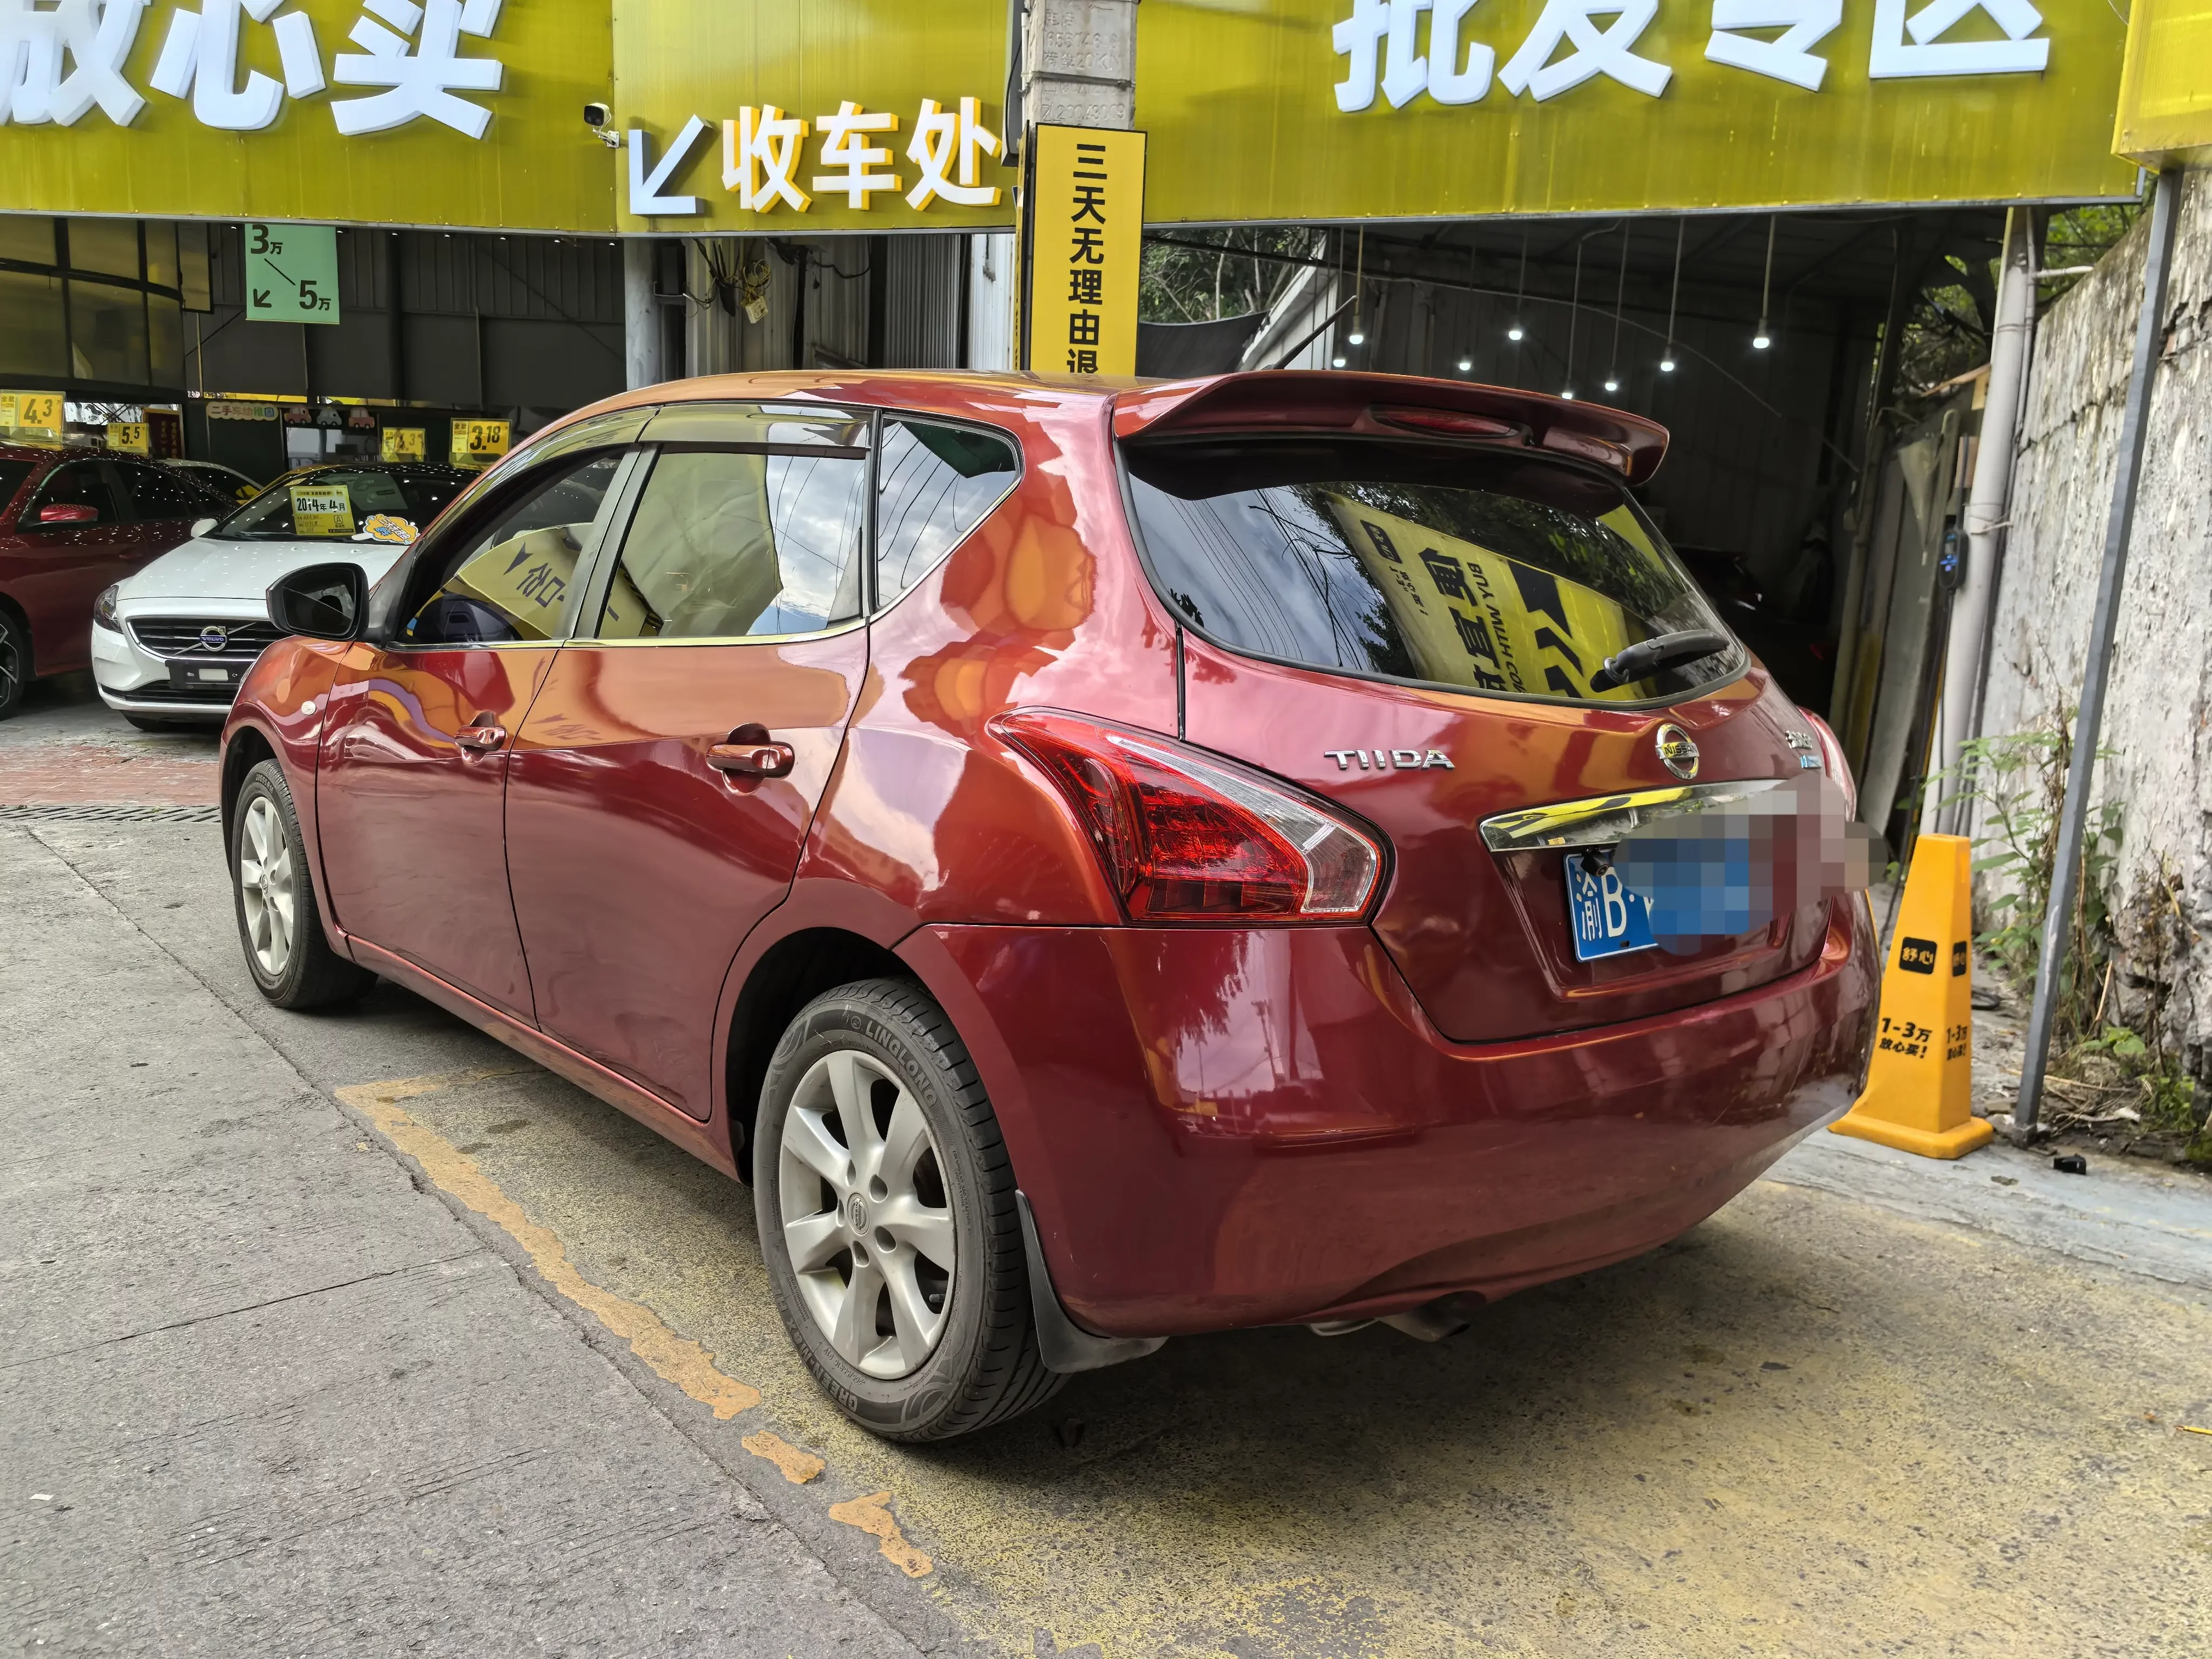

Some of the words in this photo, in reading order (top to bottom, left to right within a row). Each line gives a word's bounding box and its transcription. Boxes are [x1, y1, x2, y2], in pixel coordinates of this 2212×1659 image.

[722, 97, 1002, 213] 收车处
[251, 224, 283, 255] 3万
[1066, 143, 1108, 374] 三天无理由退
[299, 280, 331, 311] 5万
[24, 398, 53, 424] 4.3
[122, 426, 140, 444] 5.5
[470, 425, 501, 450] 3.18
[1324, 749, 1456, 770] TIIDA
[1664, 745, 1697, 756] NISSAN
[1902, 947, 1934, 965] 舒心
[1881, 1017, 1932, 1043] 1-3万
[1879, 1037, 1928, 1059] 放心买!
[865, 1020, 938, 1108] LINGLONG
